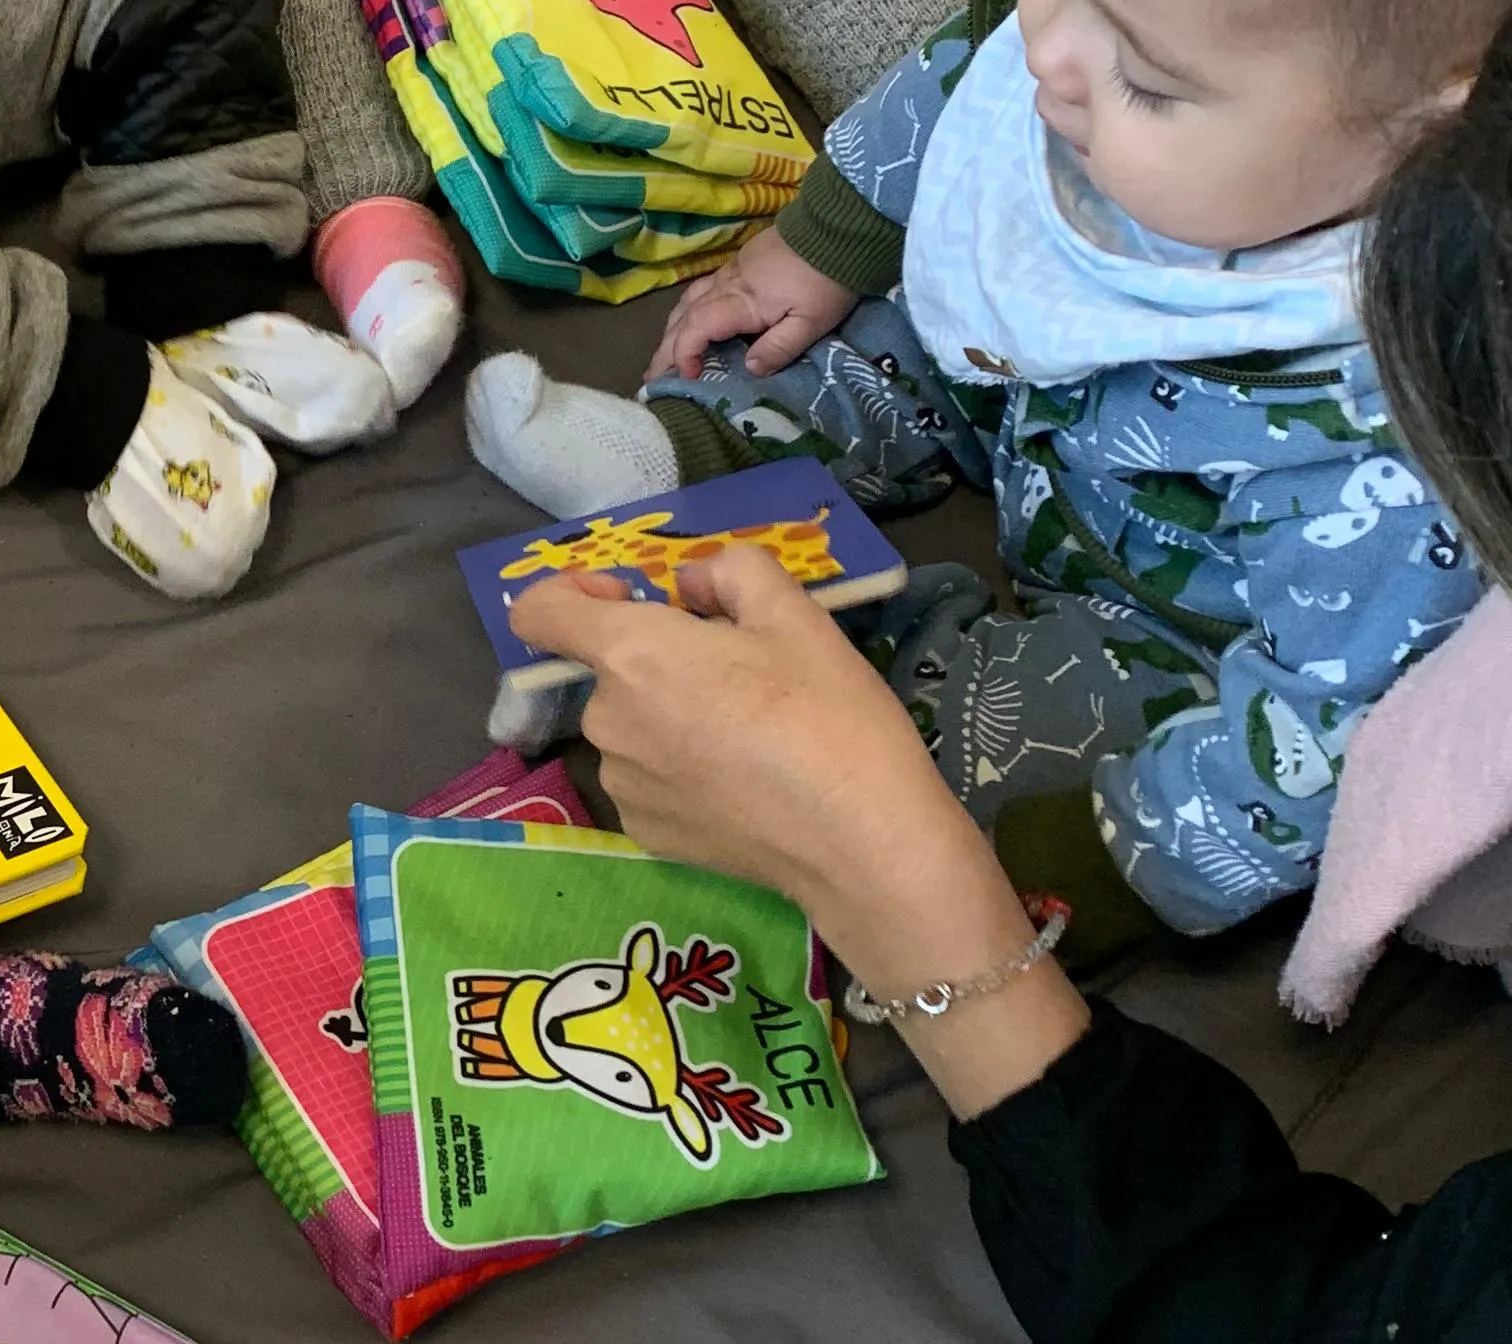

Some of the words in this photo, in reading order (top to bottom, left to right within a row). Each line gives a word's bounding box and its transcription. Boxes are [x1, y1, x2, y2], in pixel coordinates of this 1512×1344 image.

[592, 75, 794, 139] ESTRELLA
[746, 984, 834, 1109] ALCE
[450, 1114, 465, 1142] DEL
[467, 1123, 487, 1196] ANIMALES
[453, 1144, 473, 1208] BOSQUE
